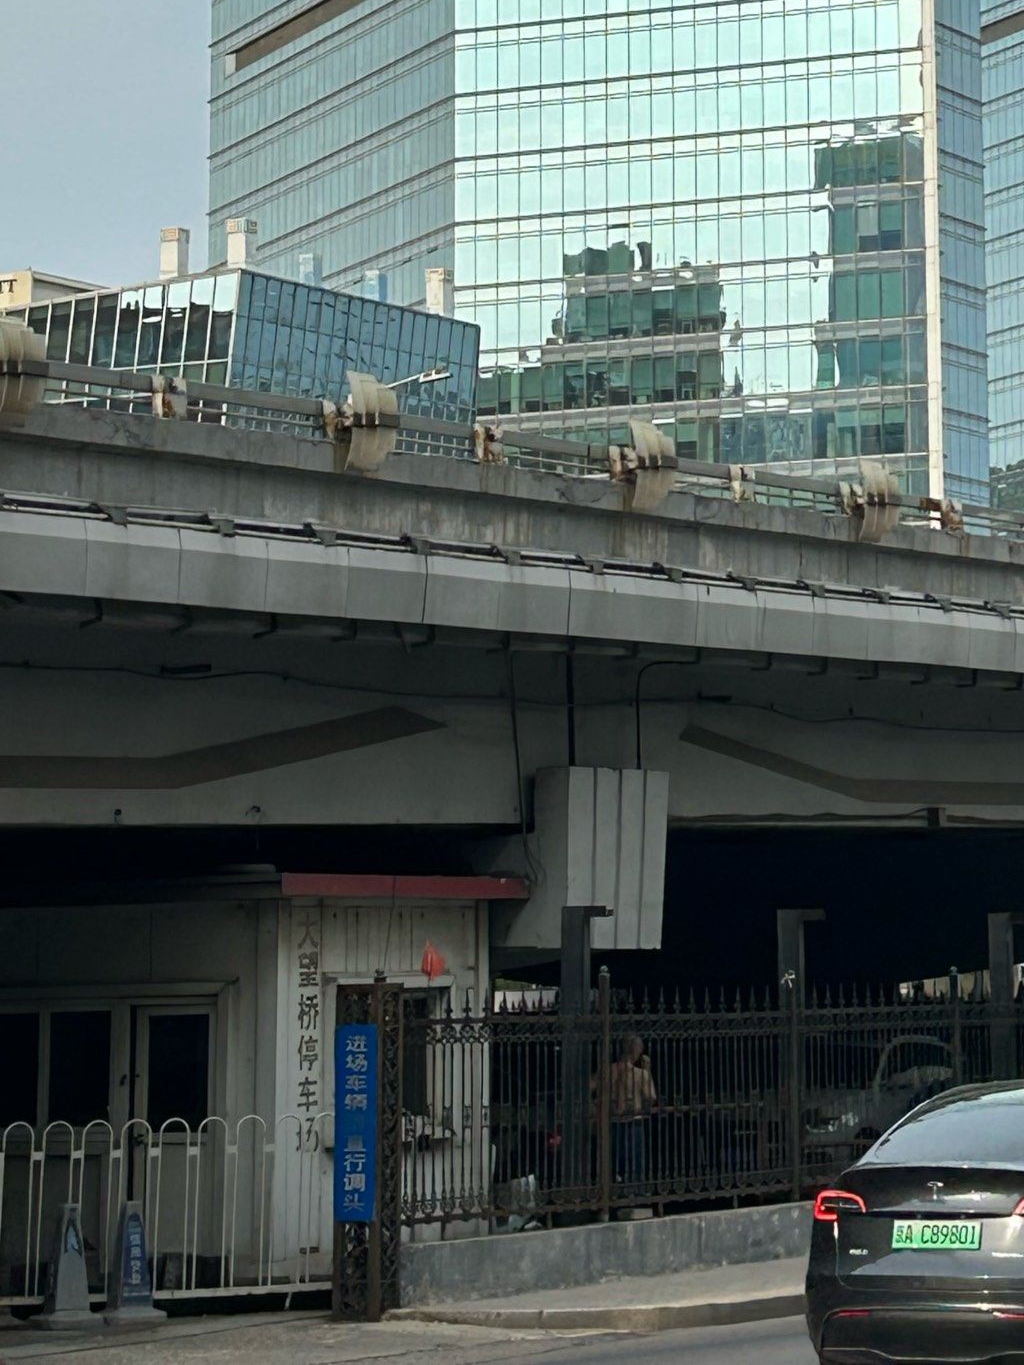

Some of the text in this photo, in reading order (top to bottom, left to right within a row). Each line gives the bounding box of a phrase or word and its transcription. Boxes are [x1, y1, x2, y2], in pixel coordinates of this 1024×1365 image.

[296, 911, 319, 1152] 大望桥停车场
[343, 1035, 368, 1212] 进场车辆直行调头
